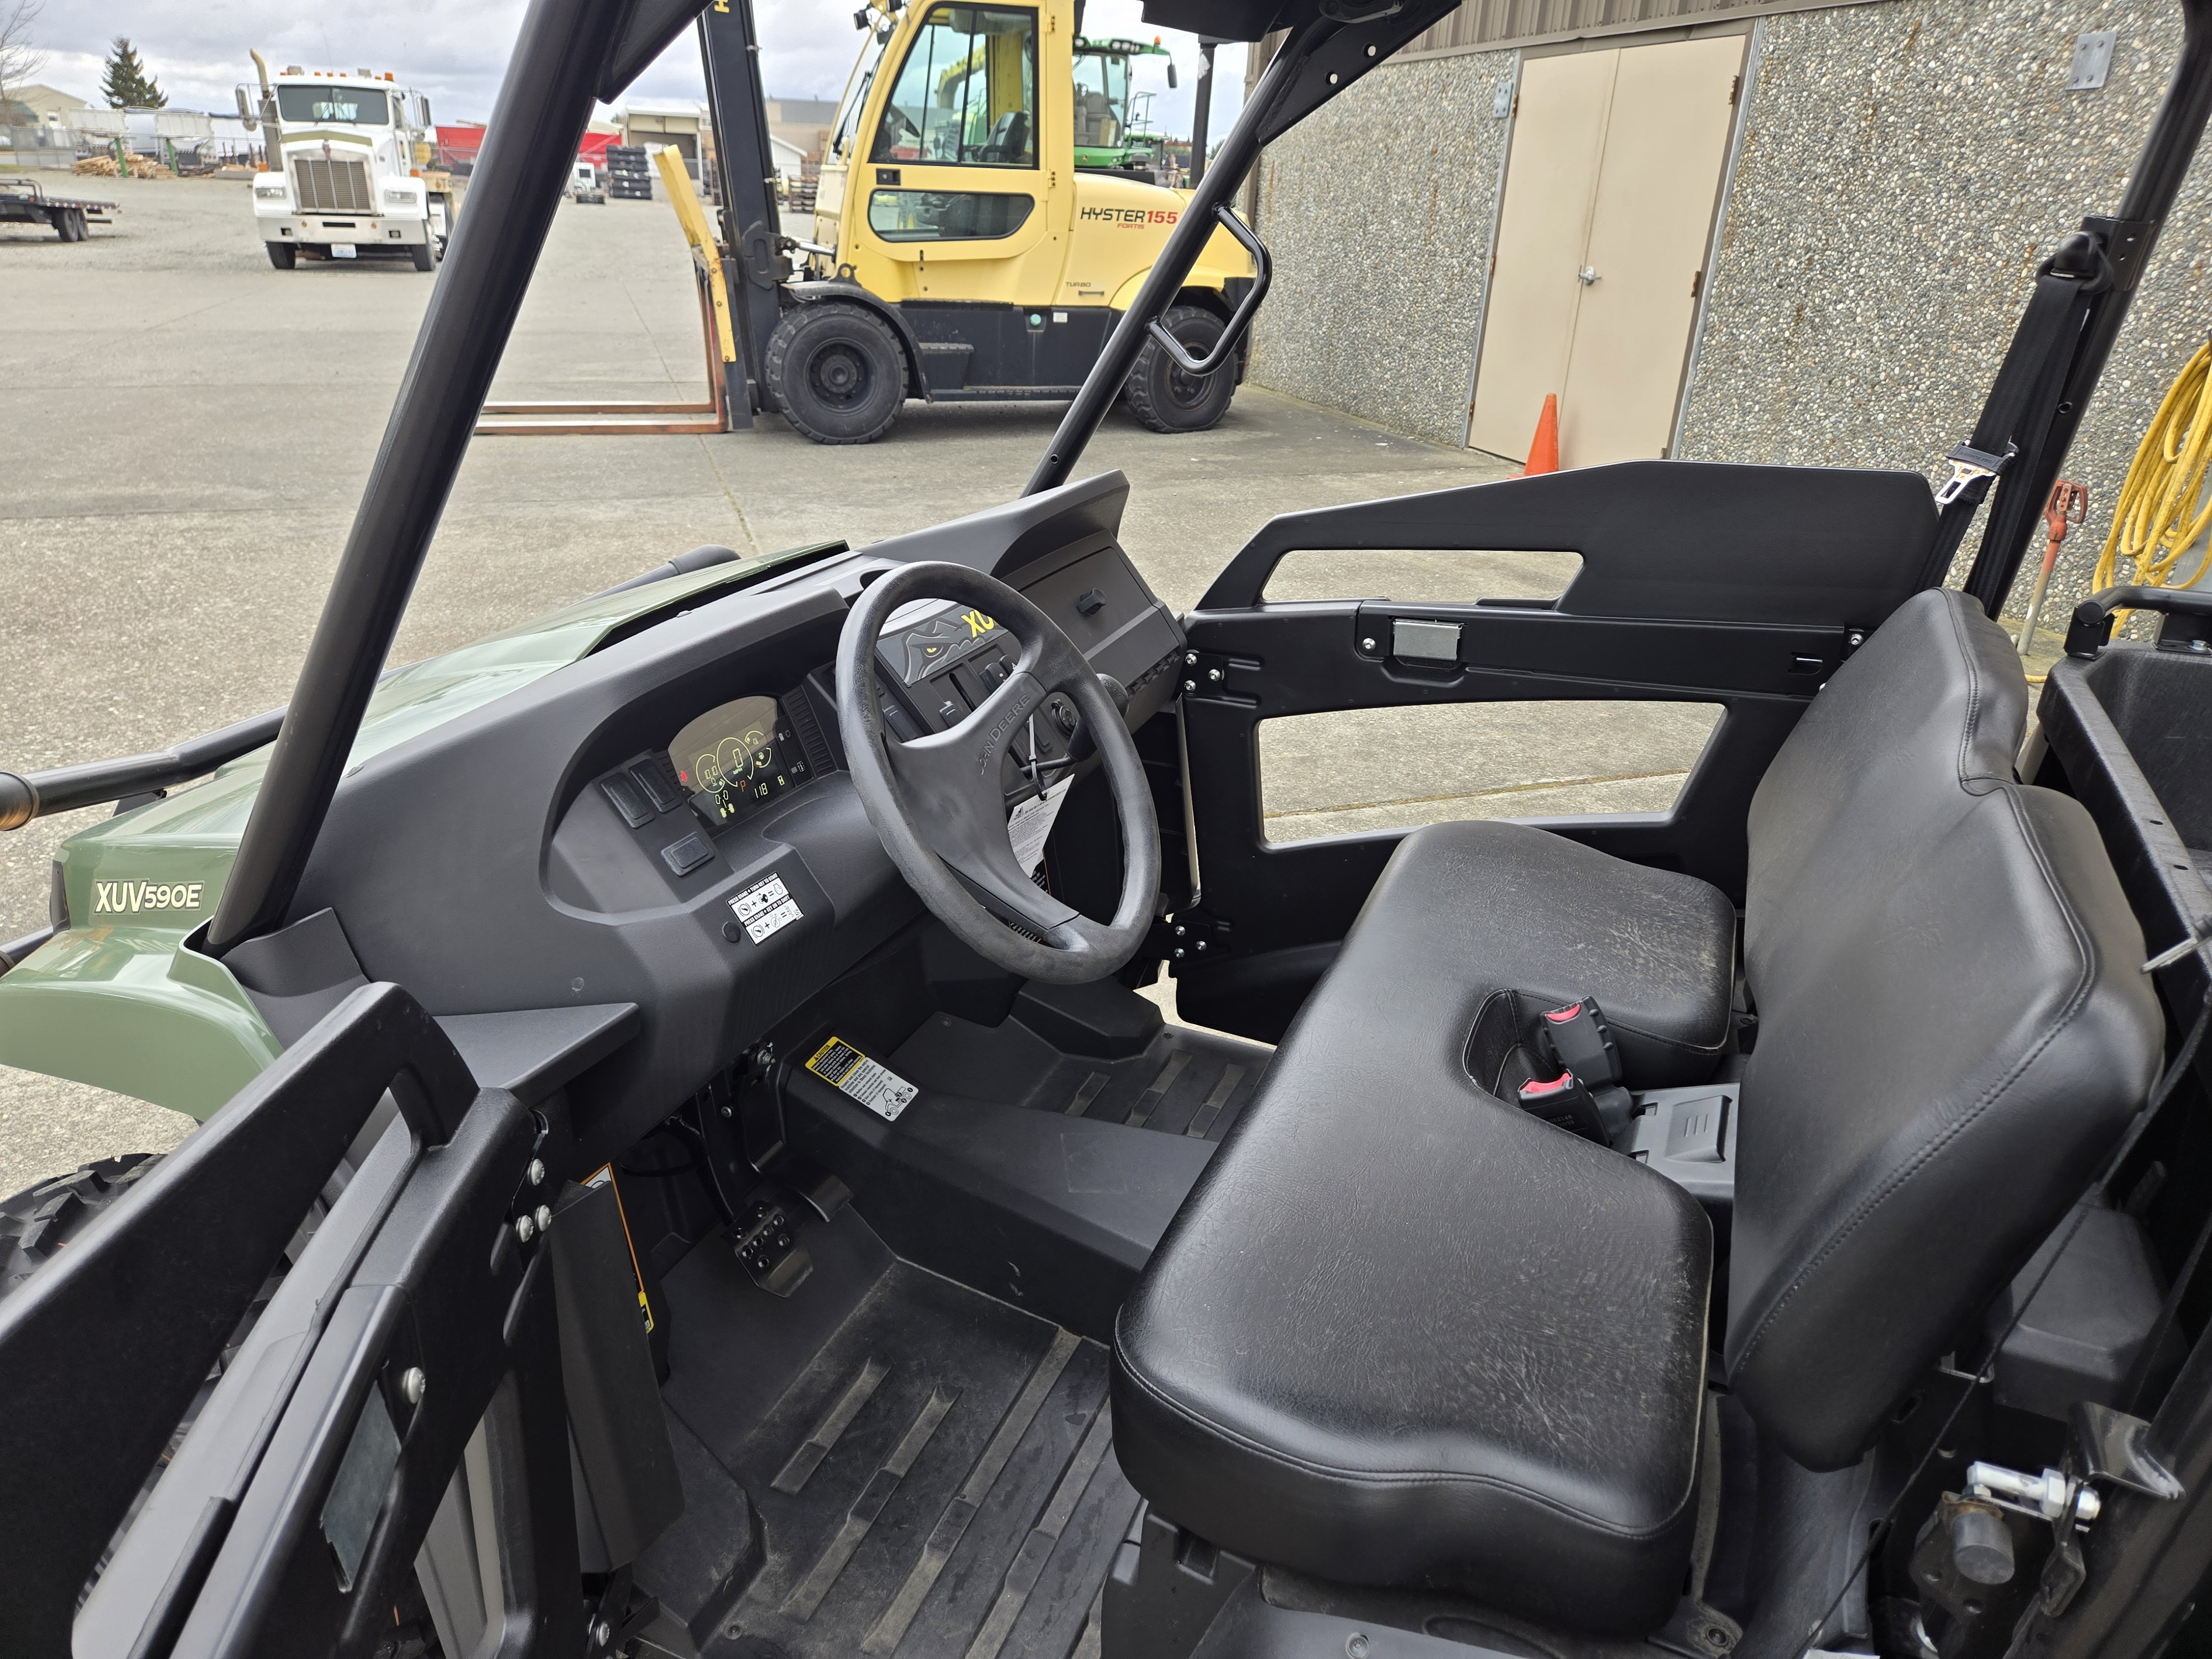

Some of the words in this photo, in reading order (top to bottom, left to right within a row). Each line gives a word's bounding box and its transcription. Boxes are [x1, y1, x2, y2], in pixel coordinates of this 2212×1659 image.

[1080, 207, 1146, 222] HYSTER
[1147, 211, 1178, 224] 155
[977, 740, 994, 775] JOHN
[989, 695, 1030, 742] DEERE
[740, 780, 746, 792] P
[94, 881, 204, 913] XUV590E
[728, 896, 739, 905] PRESS
[737, 890, 749, 900] BRAKE
[750, 884, 760, 892] TURN
[768, 873, 778, 881] START
[744, 917, 755, 926] PRESS
[753, 911, 765, 920] BRAKE
[816, 1044, 831, 1058] CAUTION
